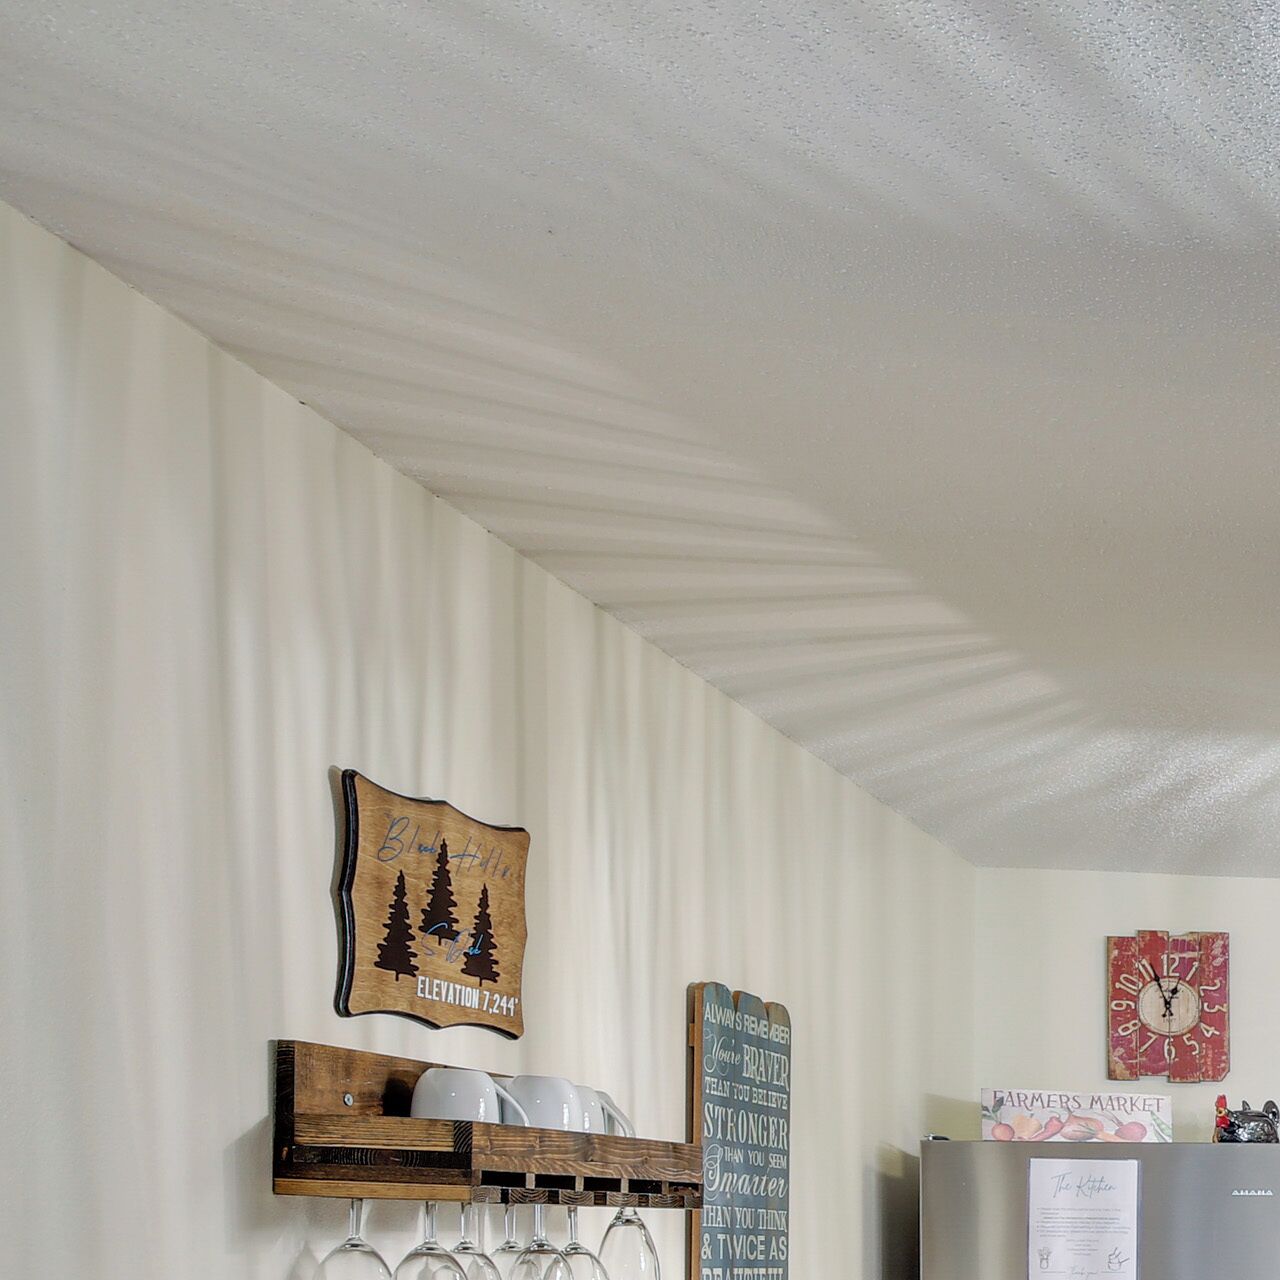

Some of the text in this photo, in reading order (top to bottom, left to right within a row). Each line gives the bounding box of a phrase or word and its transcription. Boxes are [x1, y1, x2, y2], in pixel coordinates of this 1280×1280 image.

[1161, 954, 1180, 976] 12
[1186, 961, 1199, 981] 1
[417, 975, 480, 1009] ELEVATION
[1115, 973, 1143, 996] 10
[1200, 979, 1221, 996] 2
[1111, 1000, 1135, 1011] 9
[1203, 1002, 1227, 1013] 3
[704, 1002, 790, 1045] ALWAYS REMEMBER
[1118, 1020, 1141, 1036] 8
[1200, 1022, 1220, 1038] 4
[1140, 1032, 1159, 1052] 7
[1164, 1038, 1176, 1064] 6
[1183, 1033, 1200, 1055] 5
[704, 1028, 789, 1091] You're BRAVER
[705, 1076, 788, 1110] THAN YOU BELIEVE
[992, 1090, 1164, 1114] FARMERS MARKET
[704, 1102, 788, 1150] STRONGER
[724, 1146, 787, 1169] THAN YOU SEEM
[703, 1144, 788, 1200] Smarter
[1050, 1171, 1073, 1198] The
[703, 1205, 788, 1232] THAN YOU THINK
[701, 1233, 787, 1260] & TWICE AS
